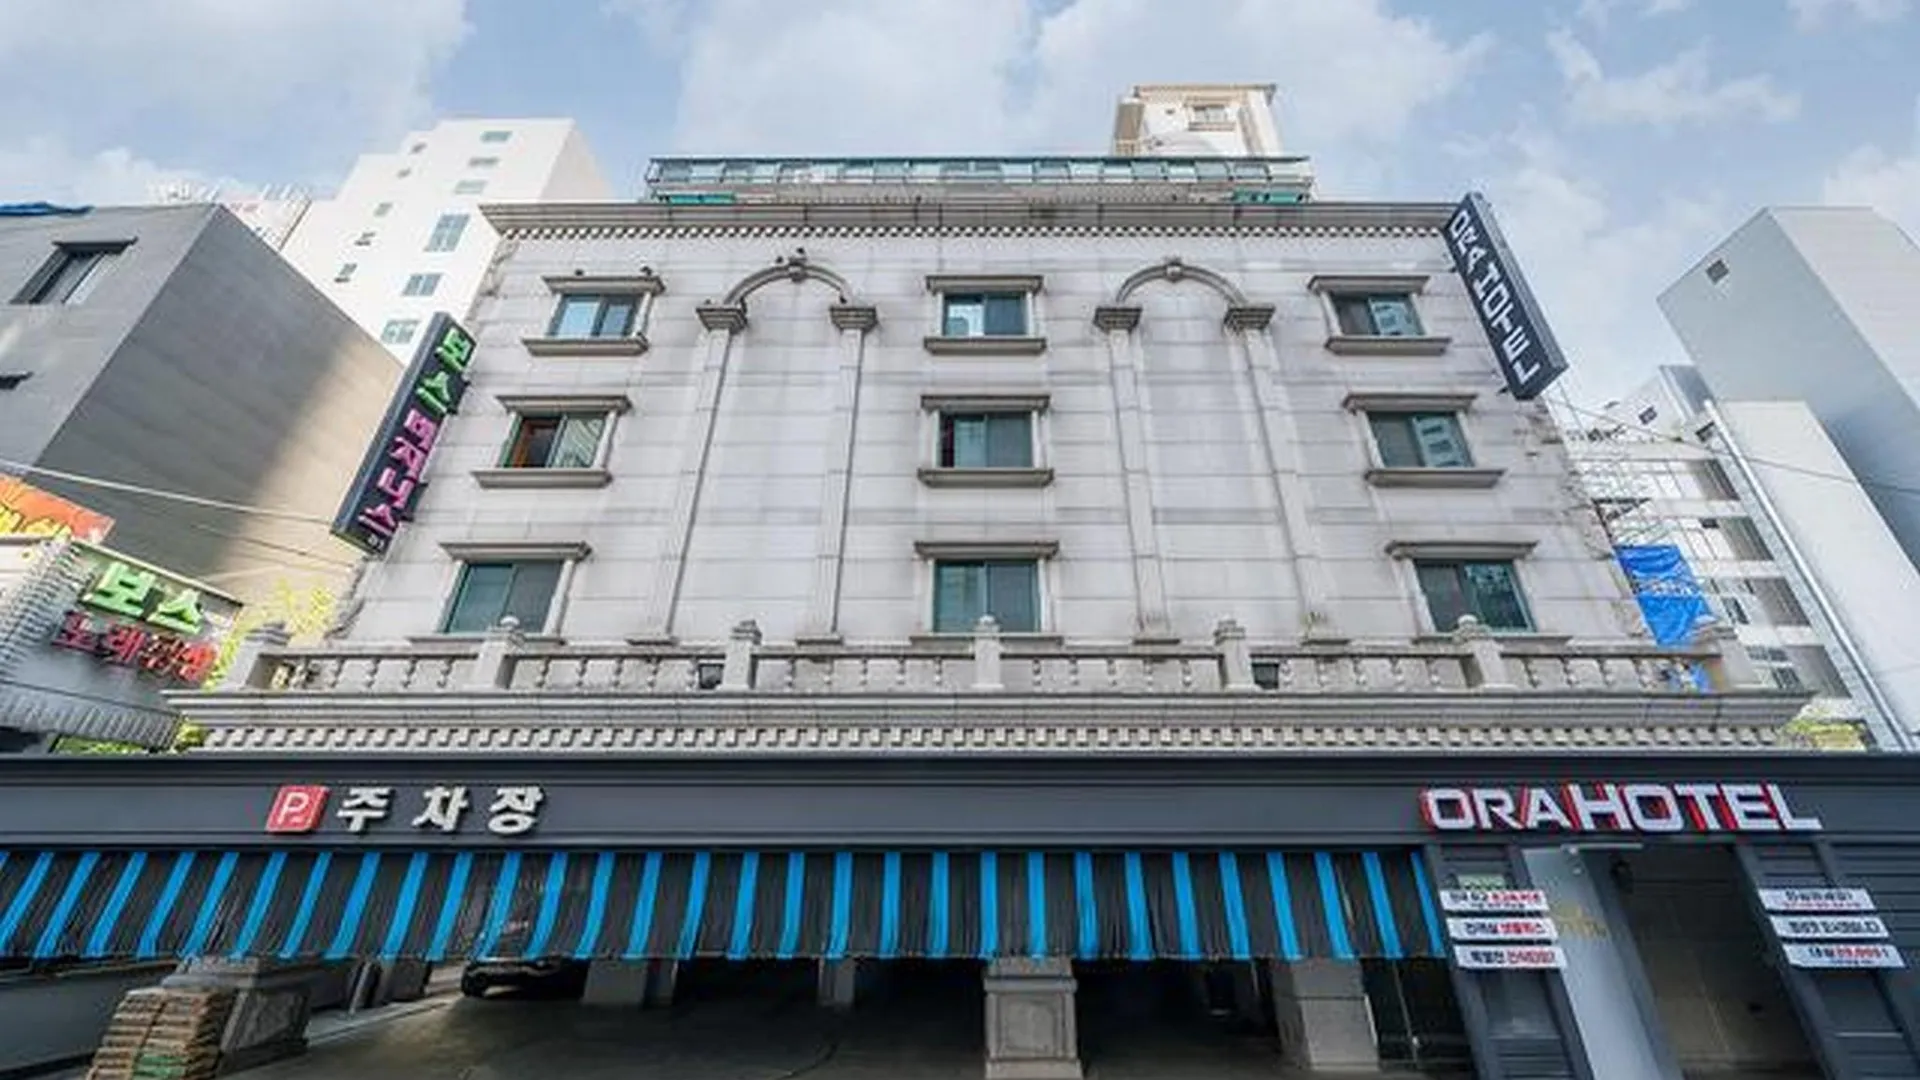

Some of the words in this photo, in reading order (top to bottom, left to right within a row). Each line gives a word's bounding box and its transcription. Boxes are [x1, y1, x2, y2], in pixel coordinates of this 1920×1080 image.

[1450, 210, 1487, 275] ORA
[1472, 262, 1541, 385] HOTEL
[82, 561, 203, 635] 보스
[336, 785, 545, 834] 주차장
